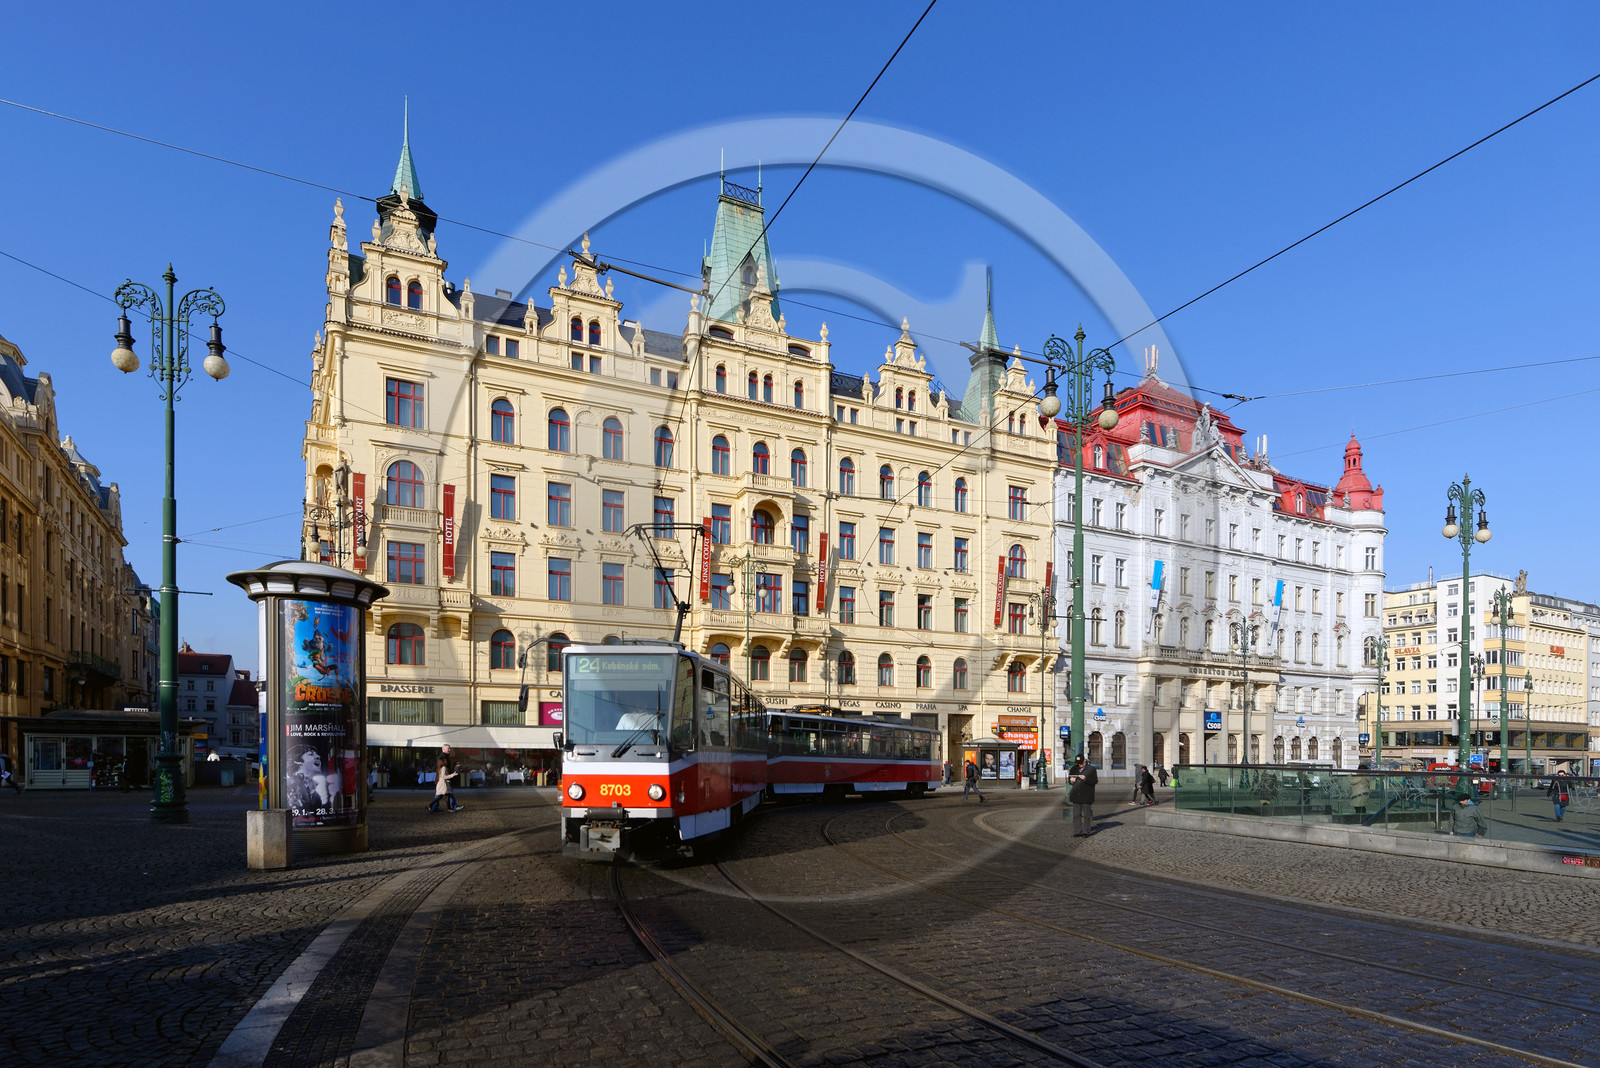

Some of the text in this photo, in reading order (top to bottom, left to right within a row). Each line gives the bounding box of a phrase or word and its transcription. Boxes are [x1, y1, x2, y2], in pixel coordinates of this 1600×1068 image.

[356, 525, 364, 548] INGS
[579, 658, 660, 673] 24 Kubánské nám.
[294, 684, 352, 702] CRUSOE
[380, 685, 435, 694] BRASSERIE
[600, 784, 631, 796] 8703
